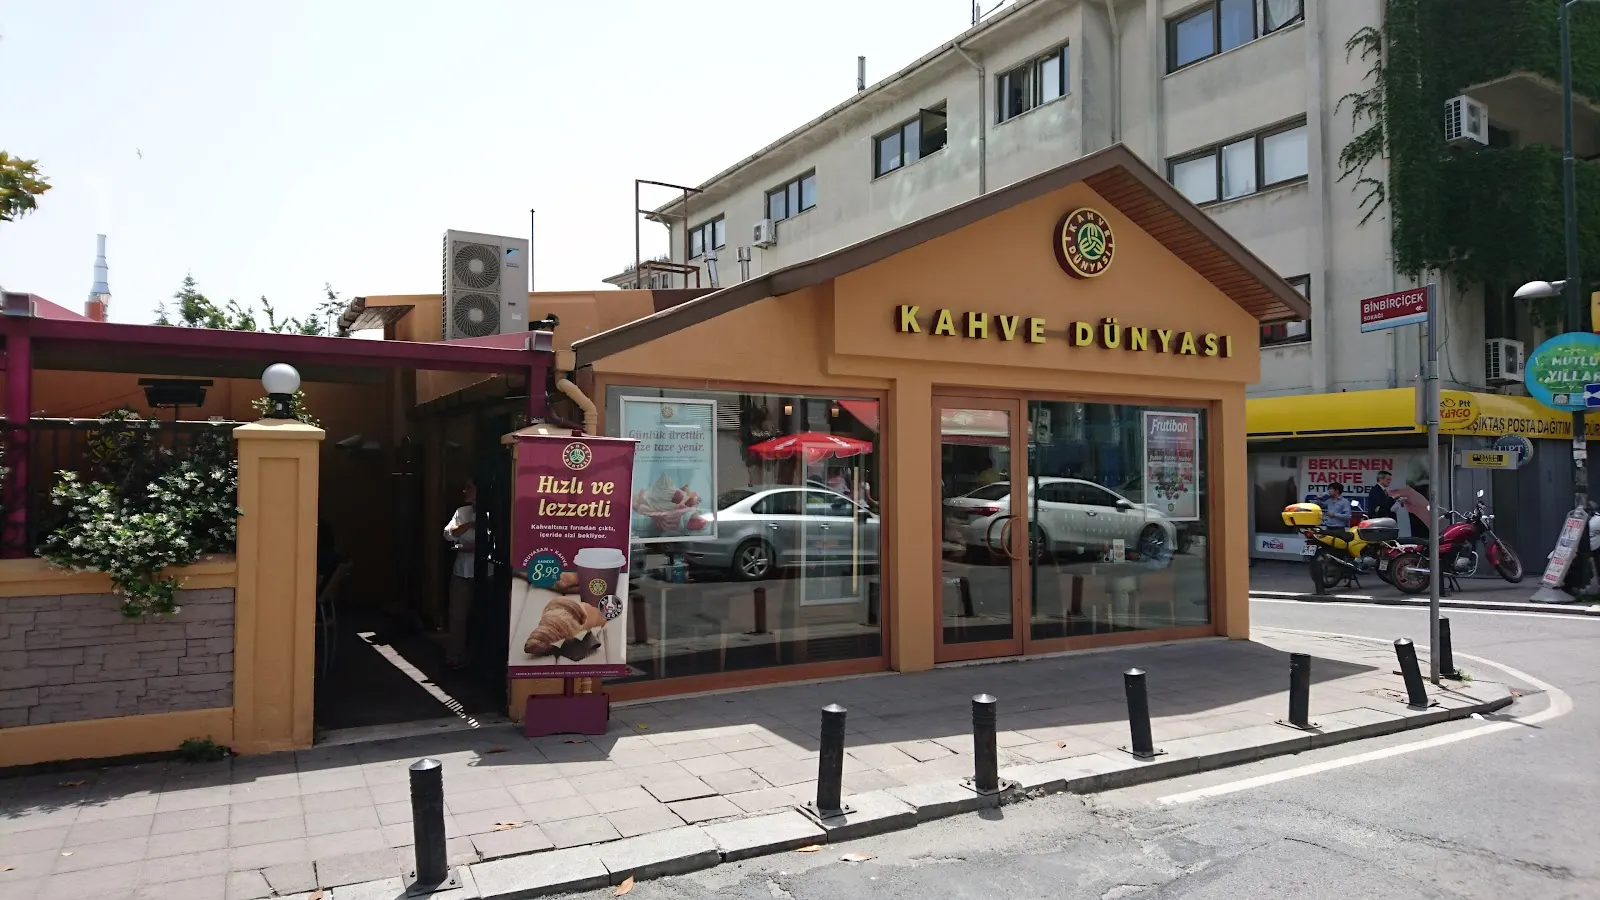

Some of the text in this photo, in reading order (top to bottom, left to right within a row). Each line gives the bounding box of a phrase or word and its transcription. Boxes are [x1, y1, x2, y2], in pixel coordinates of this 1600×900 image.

[1069, 212, 1111, 272] KAHVE DÜNYASI
[1363, 292, 1424, 313] BİNBİRÇİÇEK
[1363, 313, 1384, 321] SOKAĞI
[896, 304, 1232, 358] KAHVE DÜNYASI
[1459, 400, 1471, 408] Ptt
[629, 429, 666, 439] Günlük
[1150, 418, 1188, 434] Frutibon
[1507, 417, 1536, 433] POSTA
[1537, 418, 1571, 435] DAĞITIM
[635, 442, 705, 453] aze taze yenir.
[1308, 458, 1393, 471] BEKLENEN
[537, 475, 615, 495] Hızlı ve
[538, 498, 612, 518] lezzetli
[531, 523, 569, 531] Kahvaltınız
[570, 524, 597, 532] fırından
[577, 532, 607, 540] bekliyor.
[531, 563, 560, 581] 8,90
